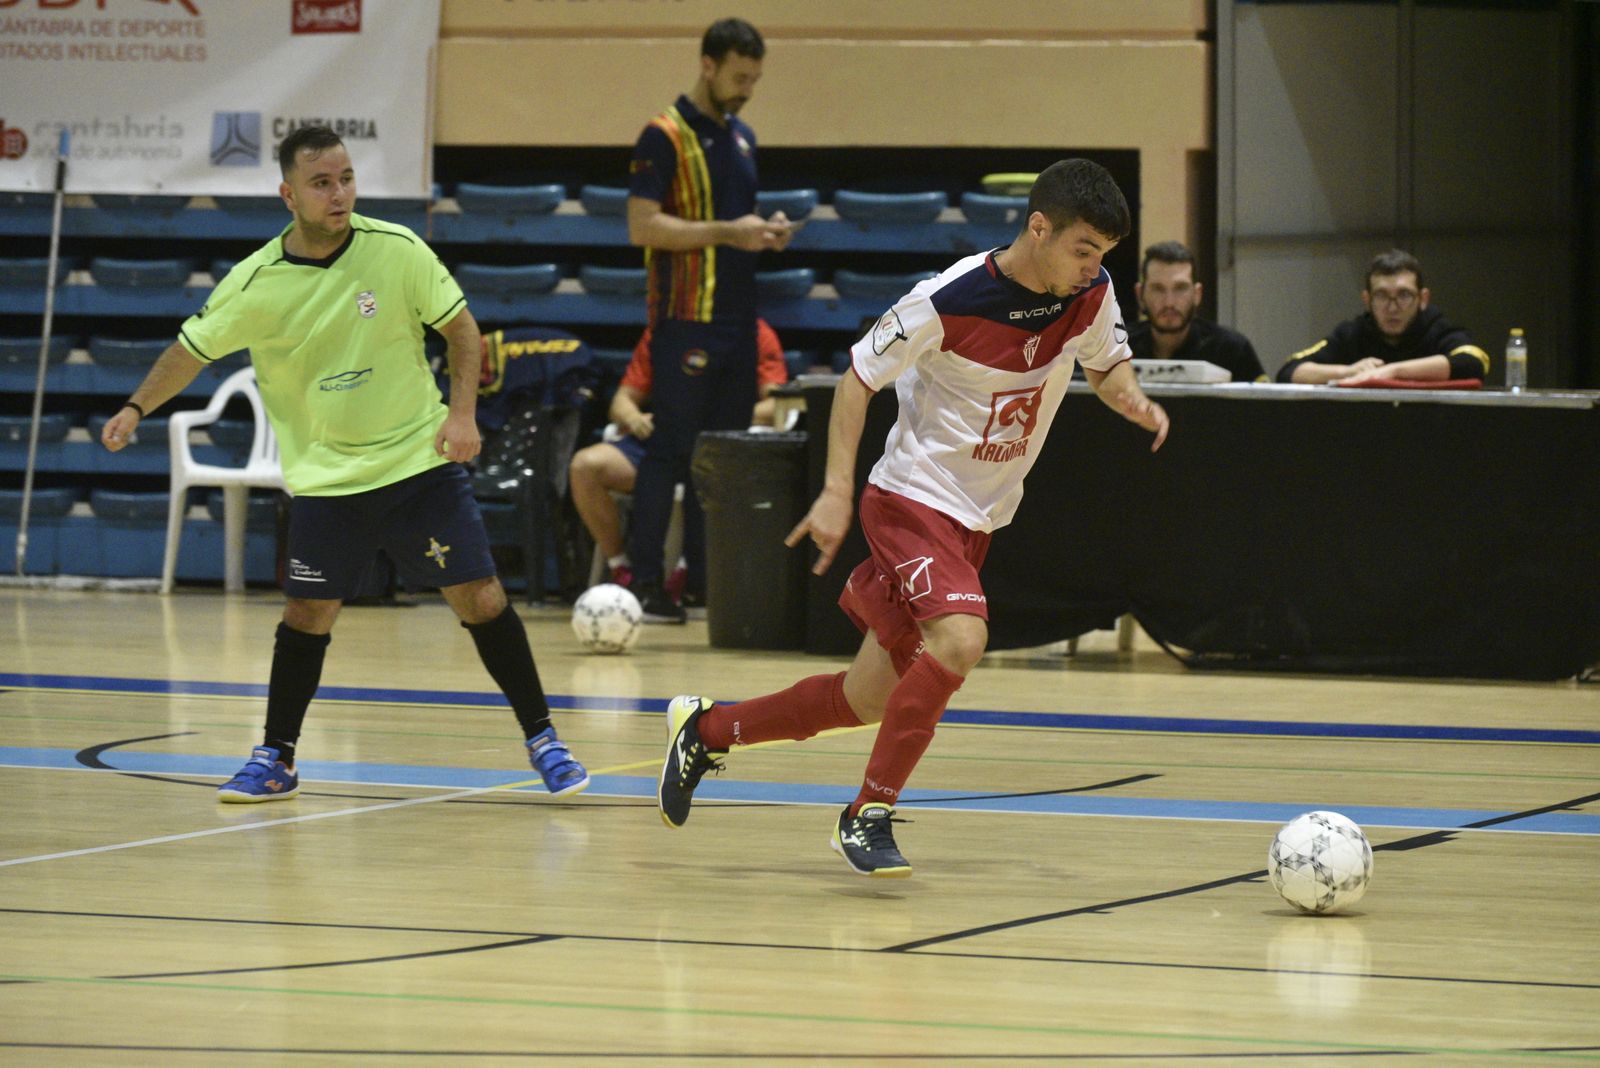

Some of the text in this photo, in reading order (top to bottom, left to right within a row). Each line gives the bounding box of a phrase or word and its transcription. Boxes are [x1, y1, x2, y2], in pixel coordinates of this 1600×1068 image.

[90, 19, 114, 37] DE
[119, 19, 205, 38] DEPORTE
[67, 43, 207, 62] INTELECTUALES
[1009, 303, 1062, 320] GIVOVA
[971, 438, 1029, 463] KALMAR
[866, 777, 899, 797] GIVOV
